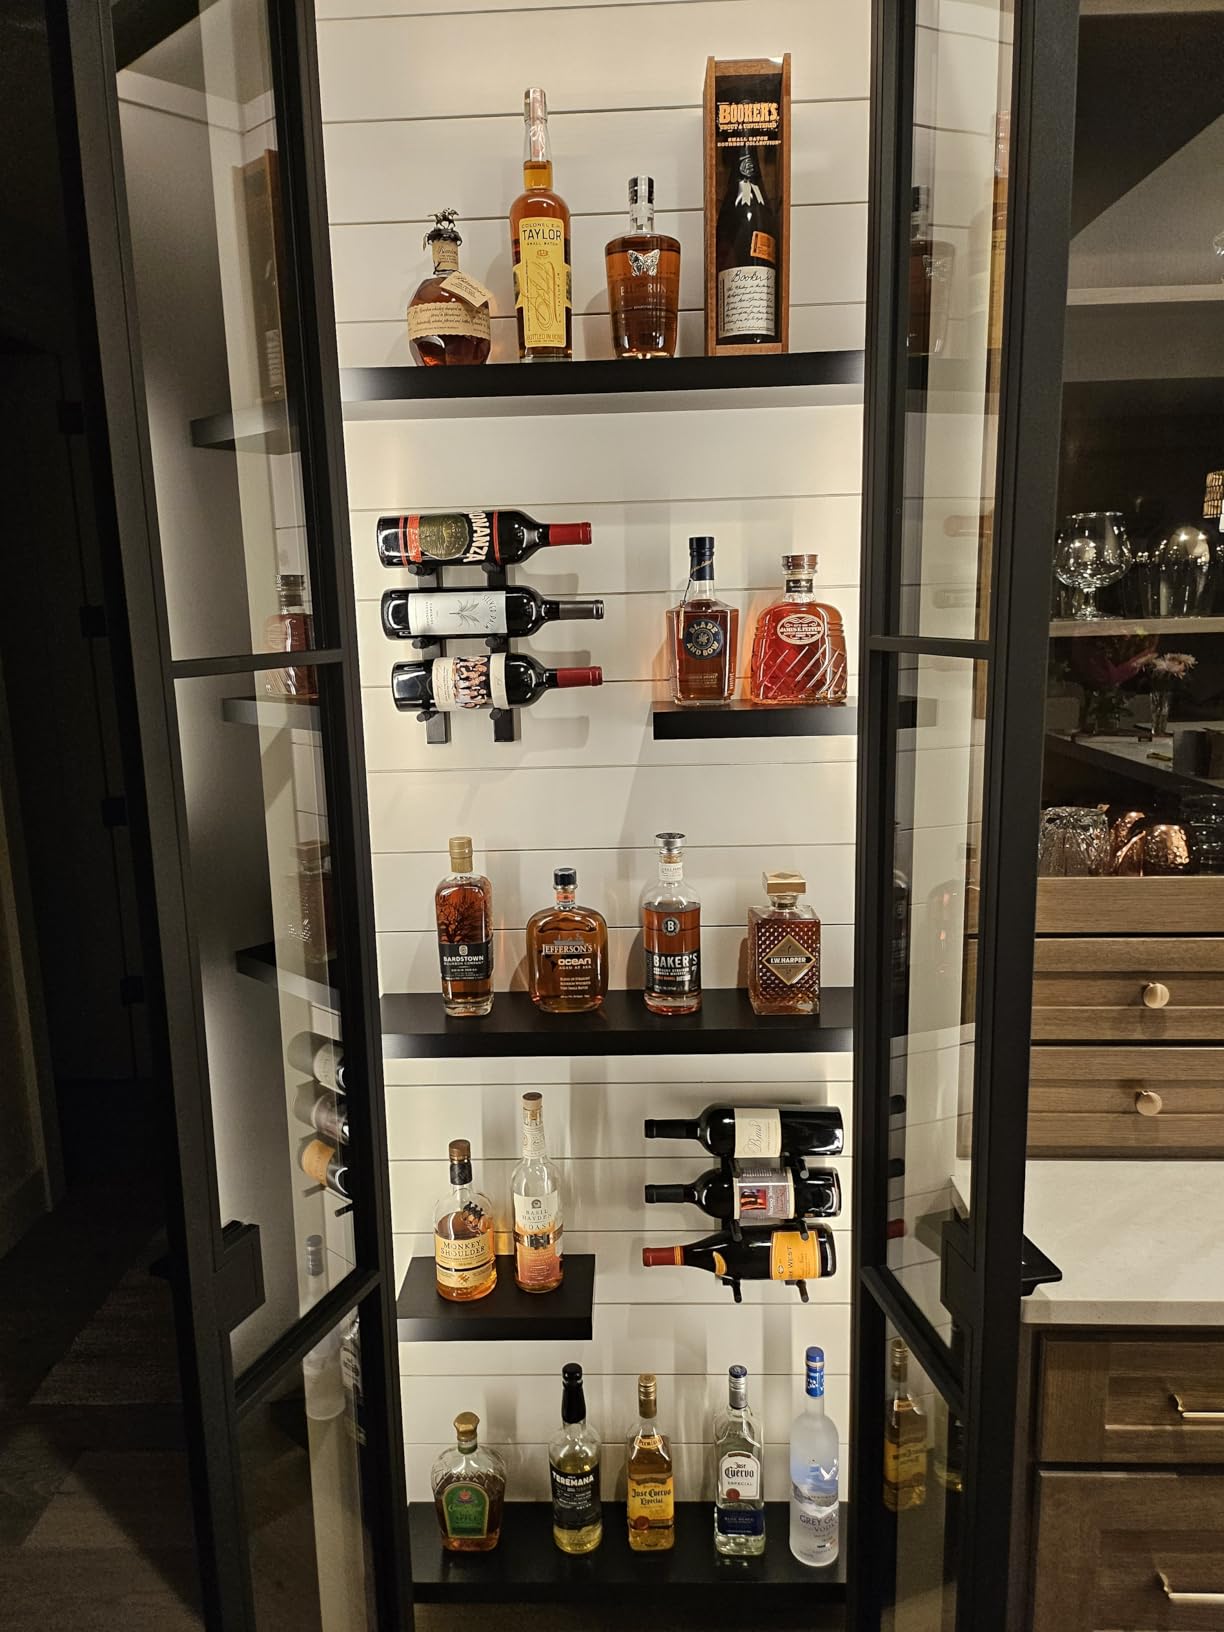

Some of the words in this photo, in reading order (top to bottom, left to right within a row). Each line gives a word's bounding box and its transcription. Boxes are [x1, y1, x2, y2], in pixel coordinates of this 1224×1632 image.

[719, 102, 778, 124] BOOKER'S
[522, 229, 561, 241] TAYLOR
[689, 621, 718, 634] BLADE
[686, 642, 702, 656] AND
[702, 641, 719, 656] BOW
[667, 920, 675, 931] B
[541, 943, 593, 955] JEFFERSON'S
[653, 953, 698, 968] BAKER'S
[443, 1240, 481, 1250] MONKEY
[440, 1246, 485, 1257] SHOULDER
[724, 1466, 754, 1479] Cuervo
[552, 1471, 594, 1487] TEREMANA
[632, 1488, 647, 1498] Jose
[648, 1488, 672, 1498] Cuervo
[799, 1514, 821, 1526] GREY
